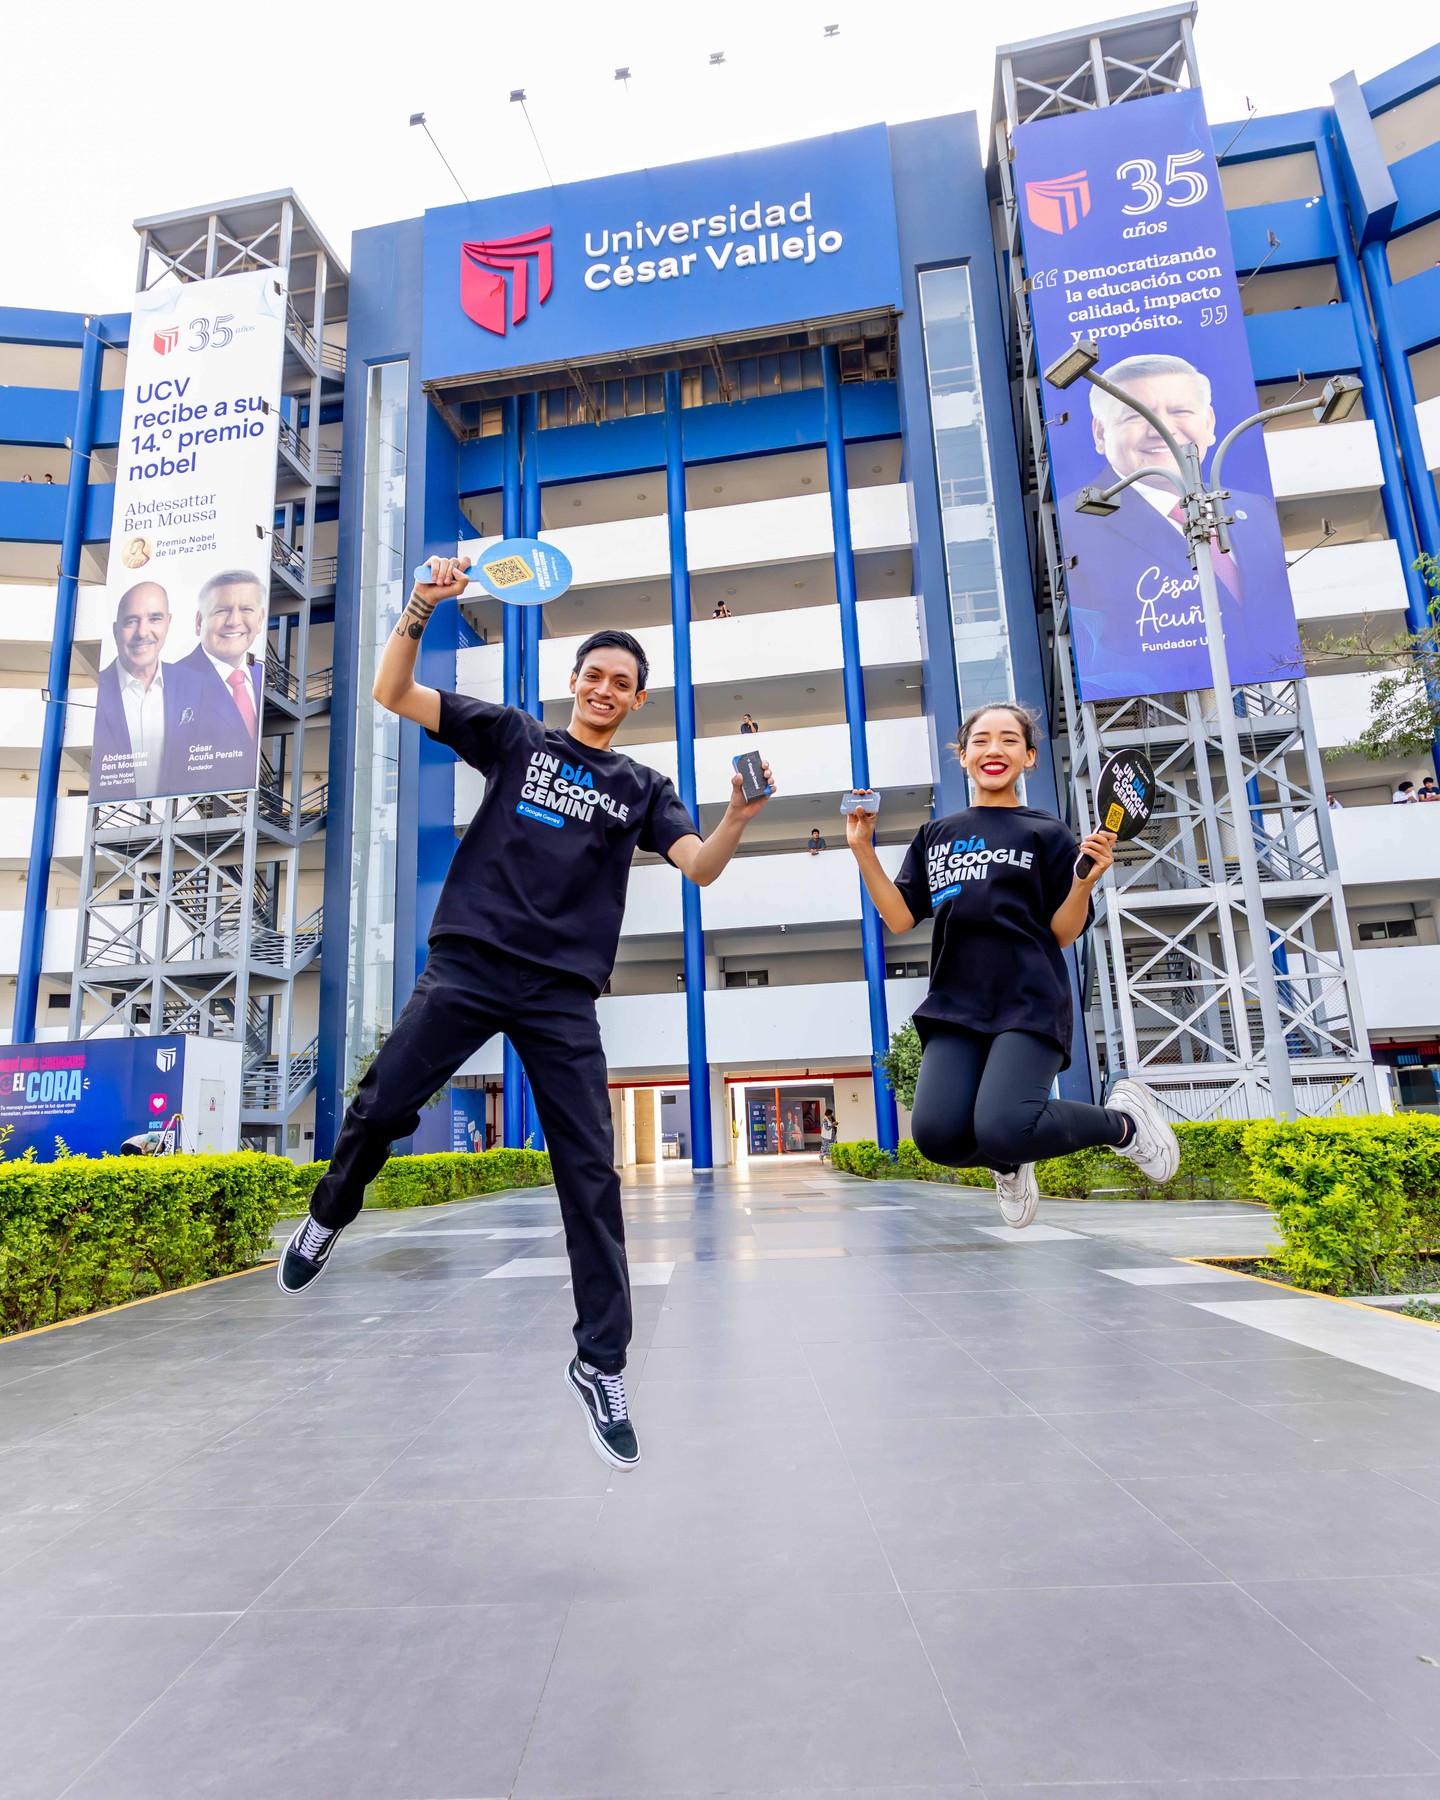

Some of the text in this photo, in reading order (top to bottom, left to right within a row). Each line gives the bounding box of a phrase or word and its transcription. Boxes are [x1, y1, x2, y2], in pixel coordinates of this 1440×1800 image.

[1116, 148, 1209, 216] 35
[584, 191, 813, 258] Universidad
[1122, 221, 1168, 239] años
[583, 225, 843, 291] César Vallejo
[1063, 246, 1217, 284] Democratizando
[1065, 265, 1222, 304] la educación con
[1068, 286, 1222, 323] calidad, impacto
[188, 313, 256, 352] 35 años
[1070, 313, 1183, 345] y propósito.
[136, 377, 191, 404] UCV
[133, 396, 262, 429] recibe a su
[178, 418, 265, 453] premio
[129, 452, 197, 481] nobel
[124, 493, 217, 517] Abdessattar
[124, 509, 217, 532] Ben Moussa
[155, 549, 167, 557] de
[178, 546, 194, 554] Paz
[196, 542, 217, 552] 2015
[156, 533, 215, 548] Premio Nobel
[1142, 638, 1197, 652] Fundador
[102, 751, 149, 762] Abdessattar
[188, 750, 243, 762] Acuña Peralta
[189, 744, 213, 753] César
[101, 760, 147, 771] Ben Moussa
[530, 751, 594, 789] UN DÍA
[1123, 762, 1135, 782] UN
[1132, 777, 1146, 799] DÍA
[521, 782, 595, 823] GEMINI
[525, 765, 629, 822] DE GOOGLE
[1111, 762, 1124, 781] DE
[1121, 778, 1149, 819] GOOGLE
[1113, 781, 1138, 819] GEMINI
[524, 806, 560, 824] Google Gemini
[928, 835, 986, 860] UN DÍA
[928, 848, 1034, 877] DE GOOGLE
[928, 864, 988, 892] GEMINI
[12, 1070, 81, 1103] EL CORA
